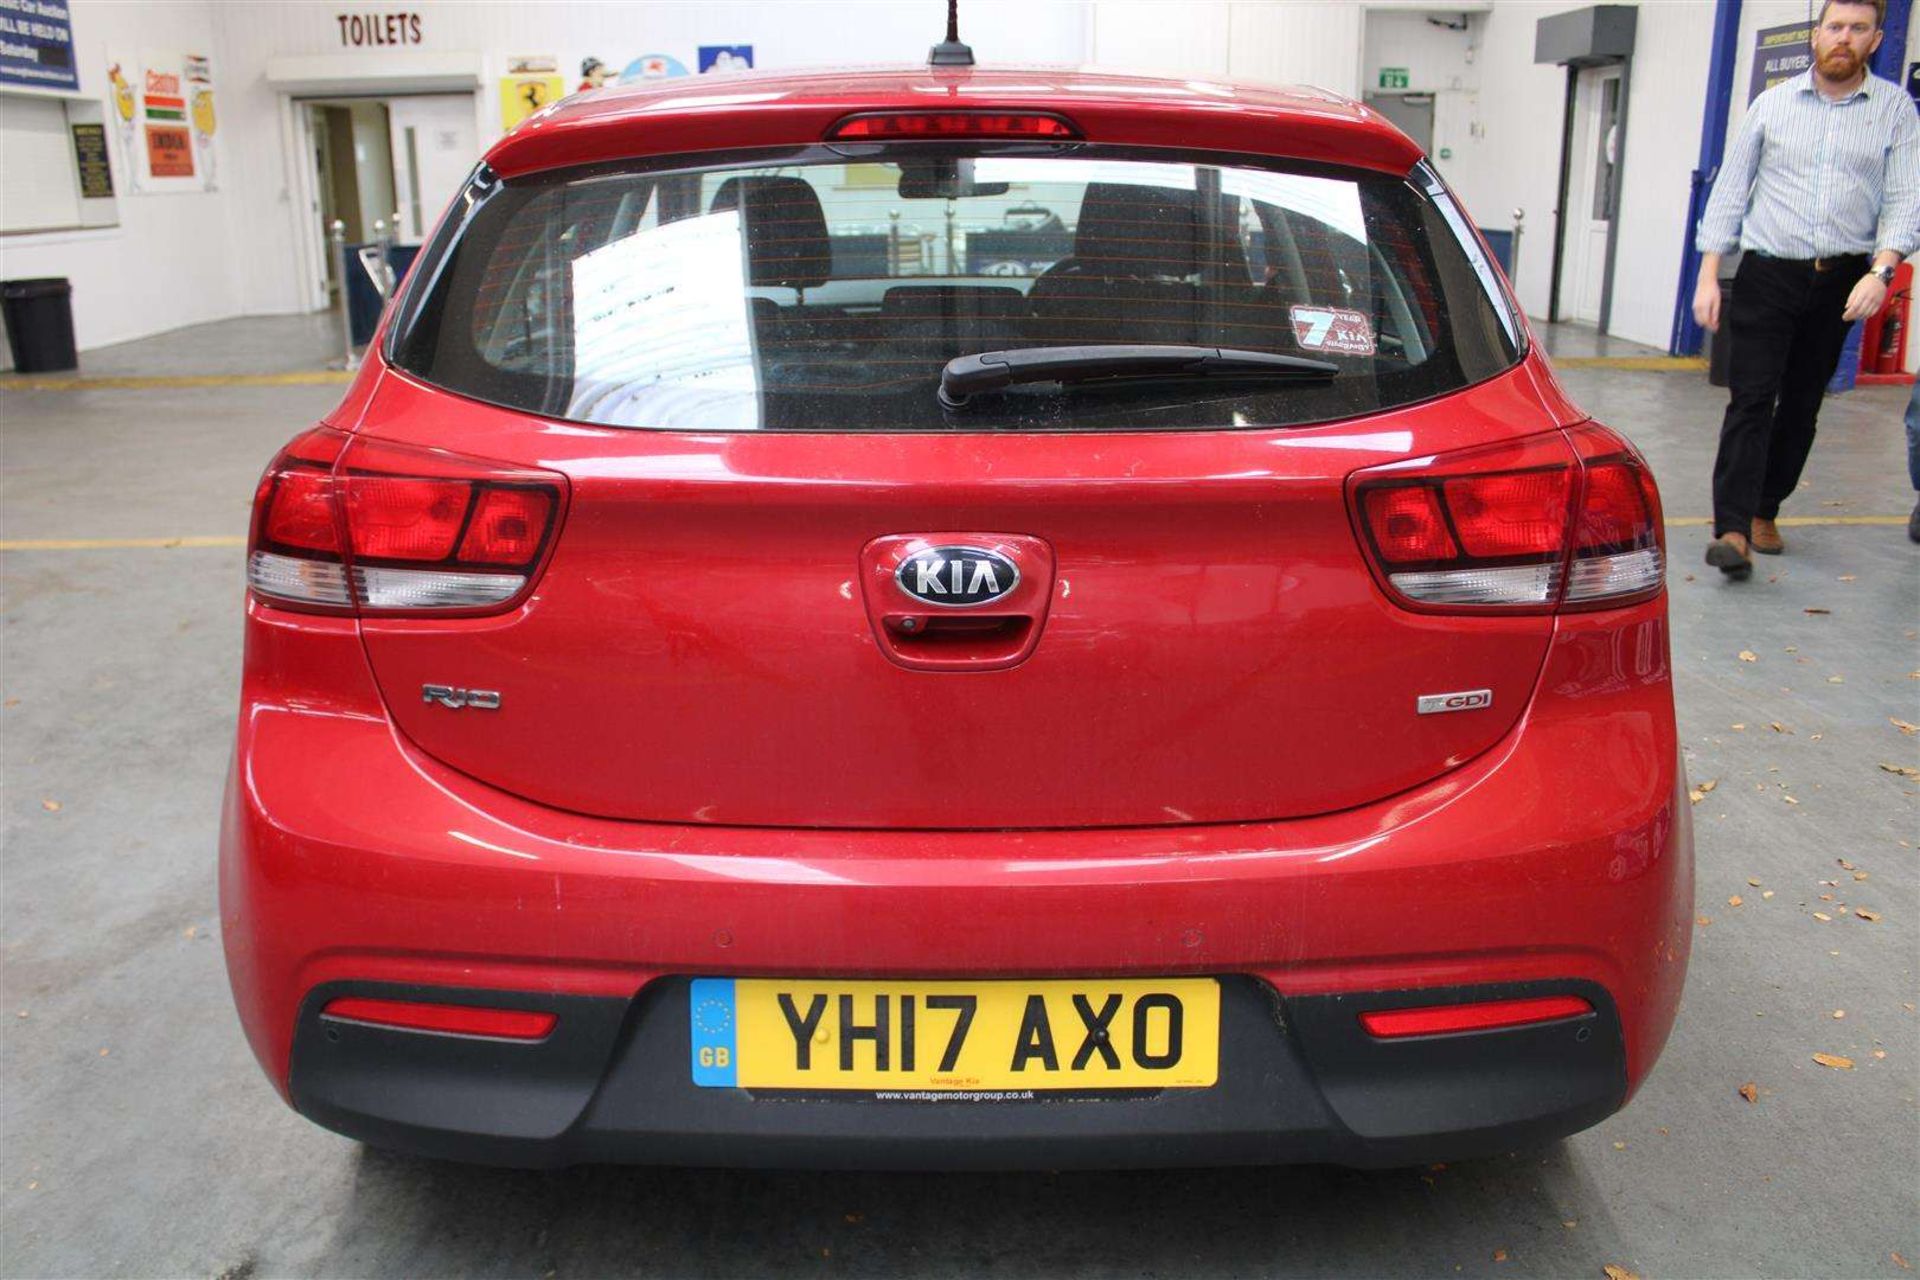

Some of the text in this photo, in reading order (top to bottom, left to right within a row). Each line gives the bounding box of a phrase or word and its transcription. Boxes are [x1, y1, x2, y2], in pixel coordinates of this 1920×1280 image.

[337, 13, 421, 46] TOILETS
[1764, 60, 1779, 73] ALL
[1294, 309, 1336, 346] 7
[915, 559, 1000, 595] KIA
[777, 993, 1184, 1073] YH17 AXO
[699, 1047, 730, 1068] GB
[875, 1090, 1034, 1101] www.vantagemotorgroup.co.uk
[930, 1077, 963, 1087] Vantage
